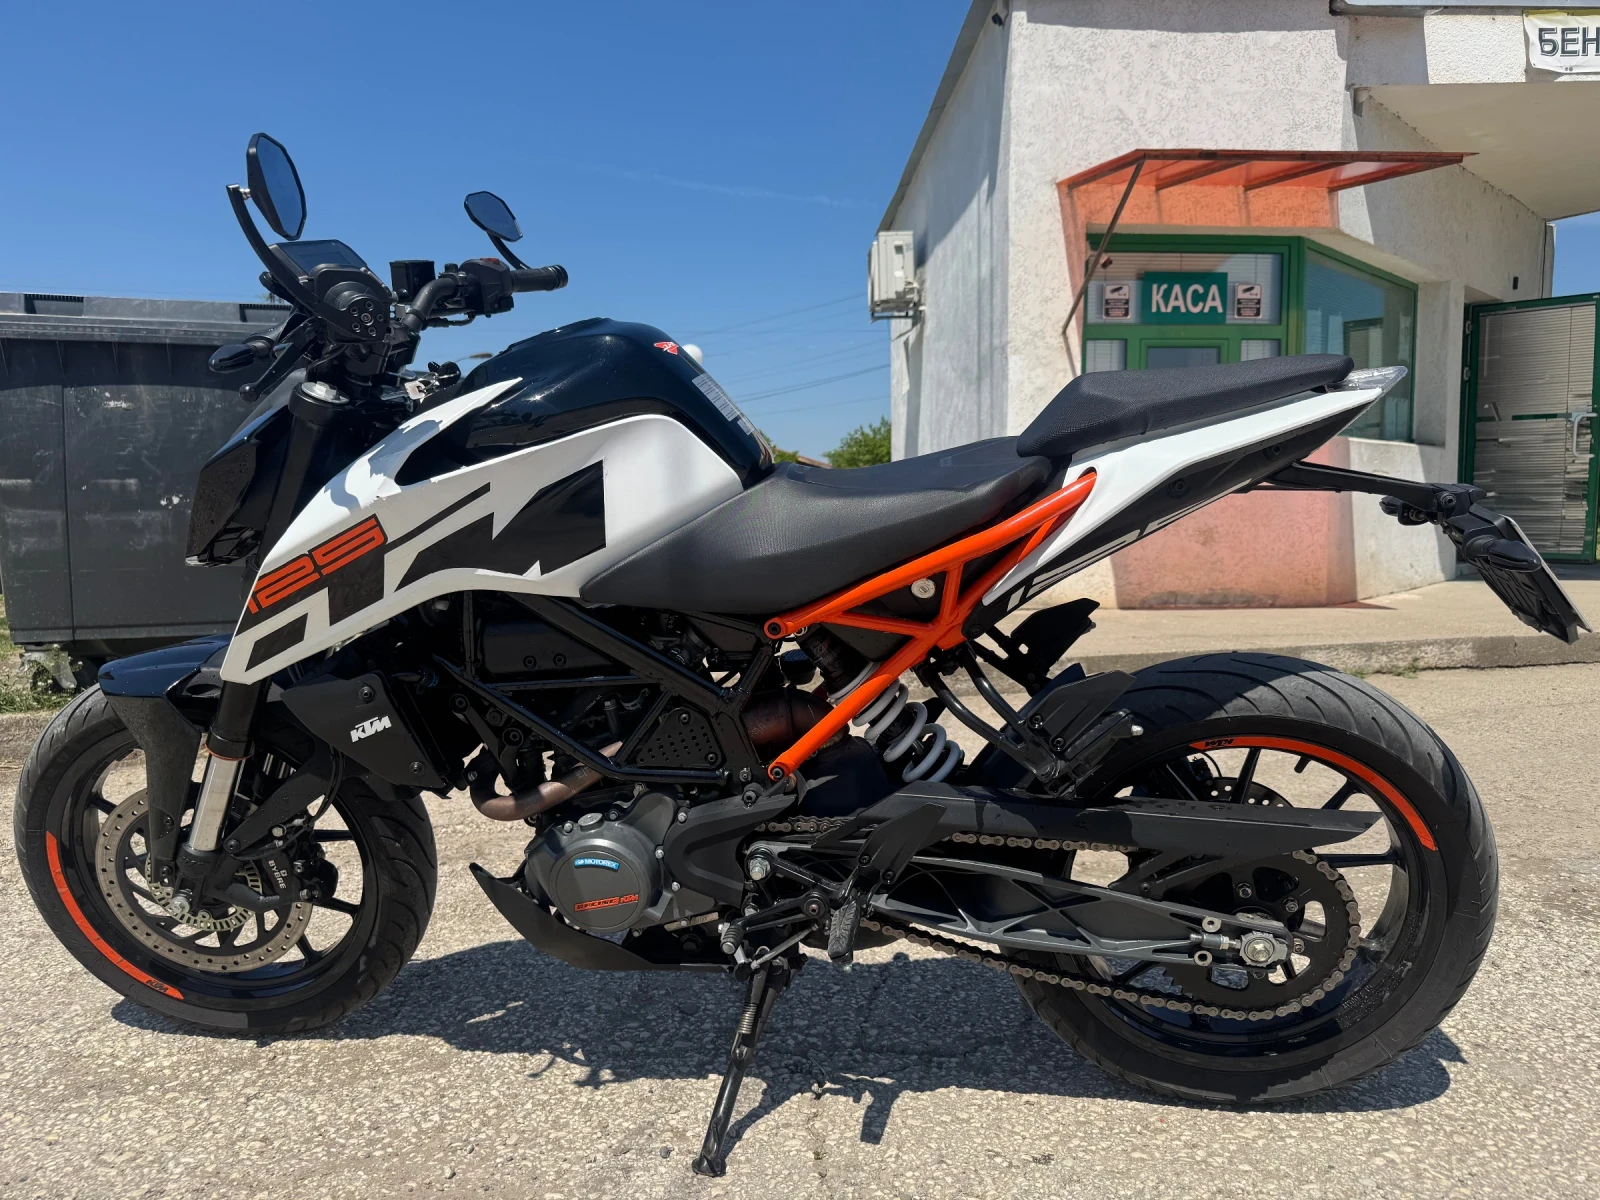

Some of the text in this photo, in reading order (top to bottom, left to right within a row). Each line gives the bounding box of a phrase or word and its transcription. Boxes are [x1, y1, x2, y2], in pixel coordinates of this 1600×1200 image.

[1538, 27, 1600, 56] БЕН
[1151, 283, 1224, 313] КАСА
[350, 715, 392, 743] KTM
[268, 859, 287, 889] BYBRE
